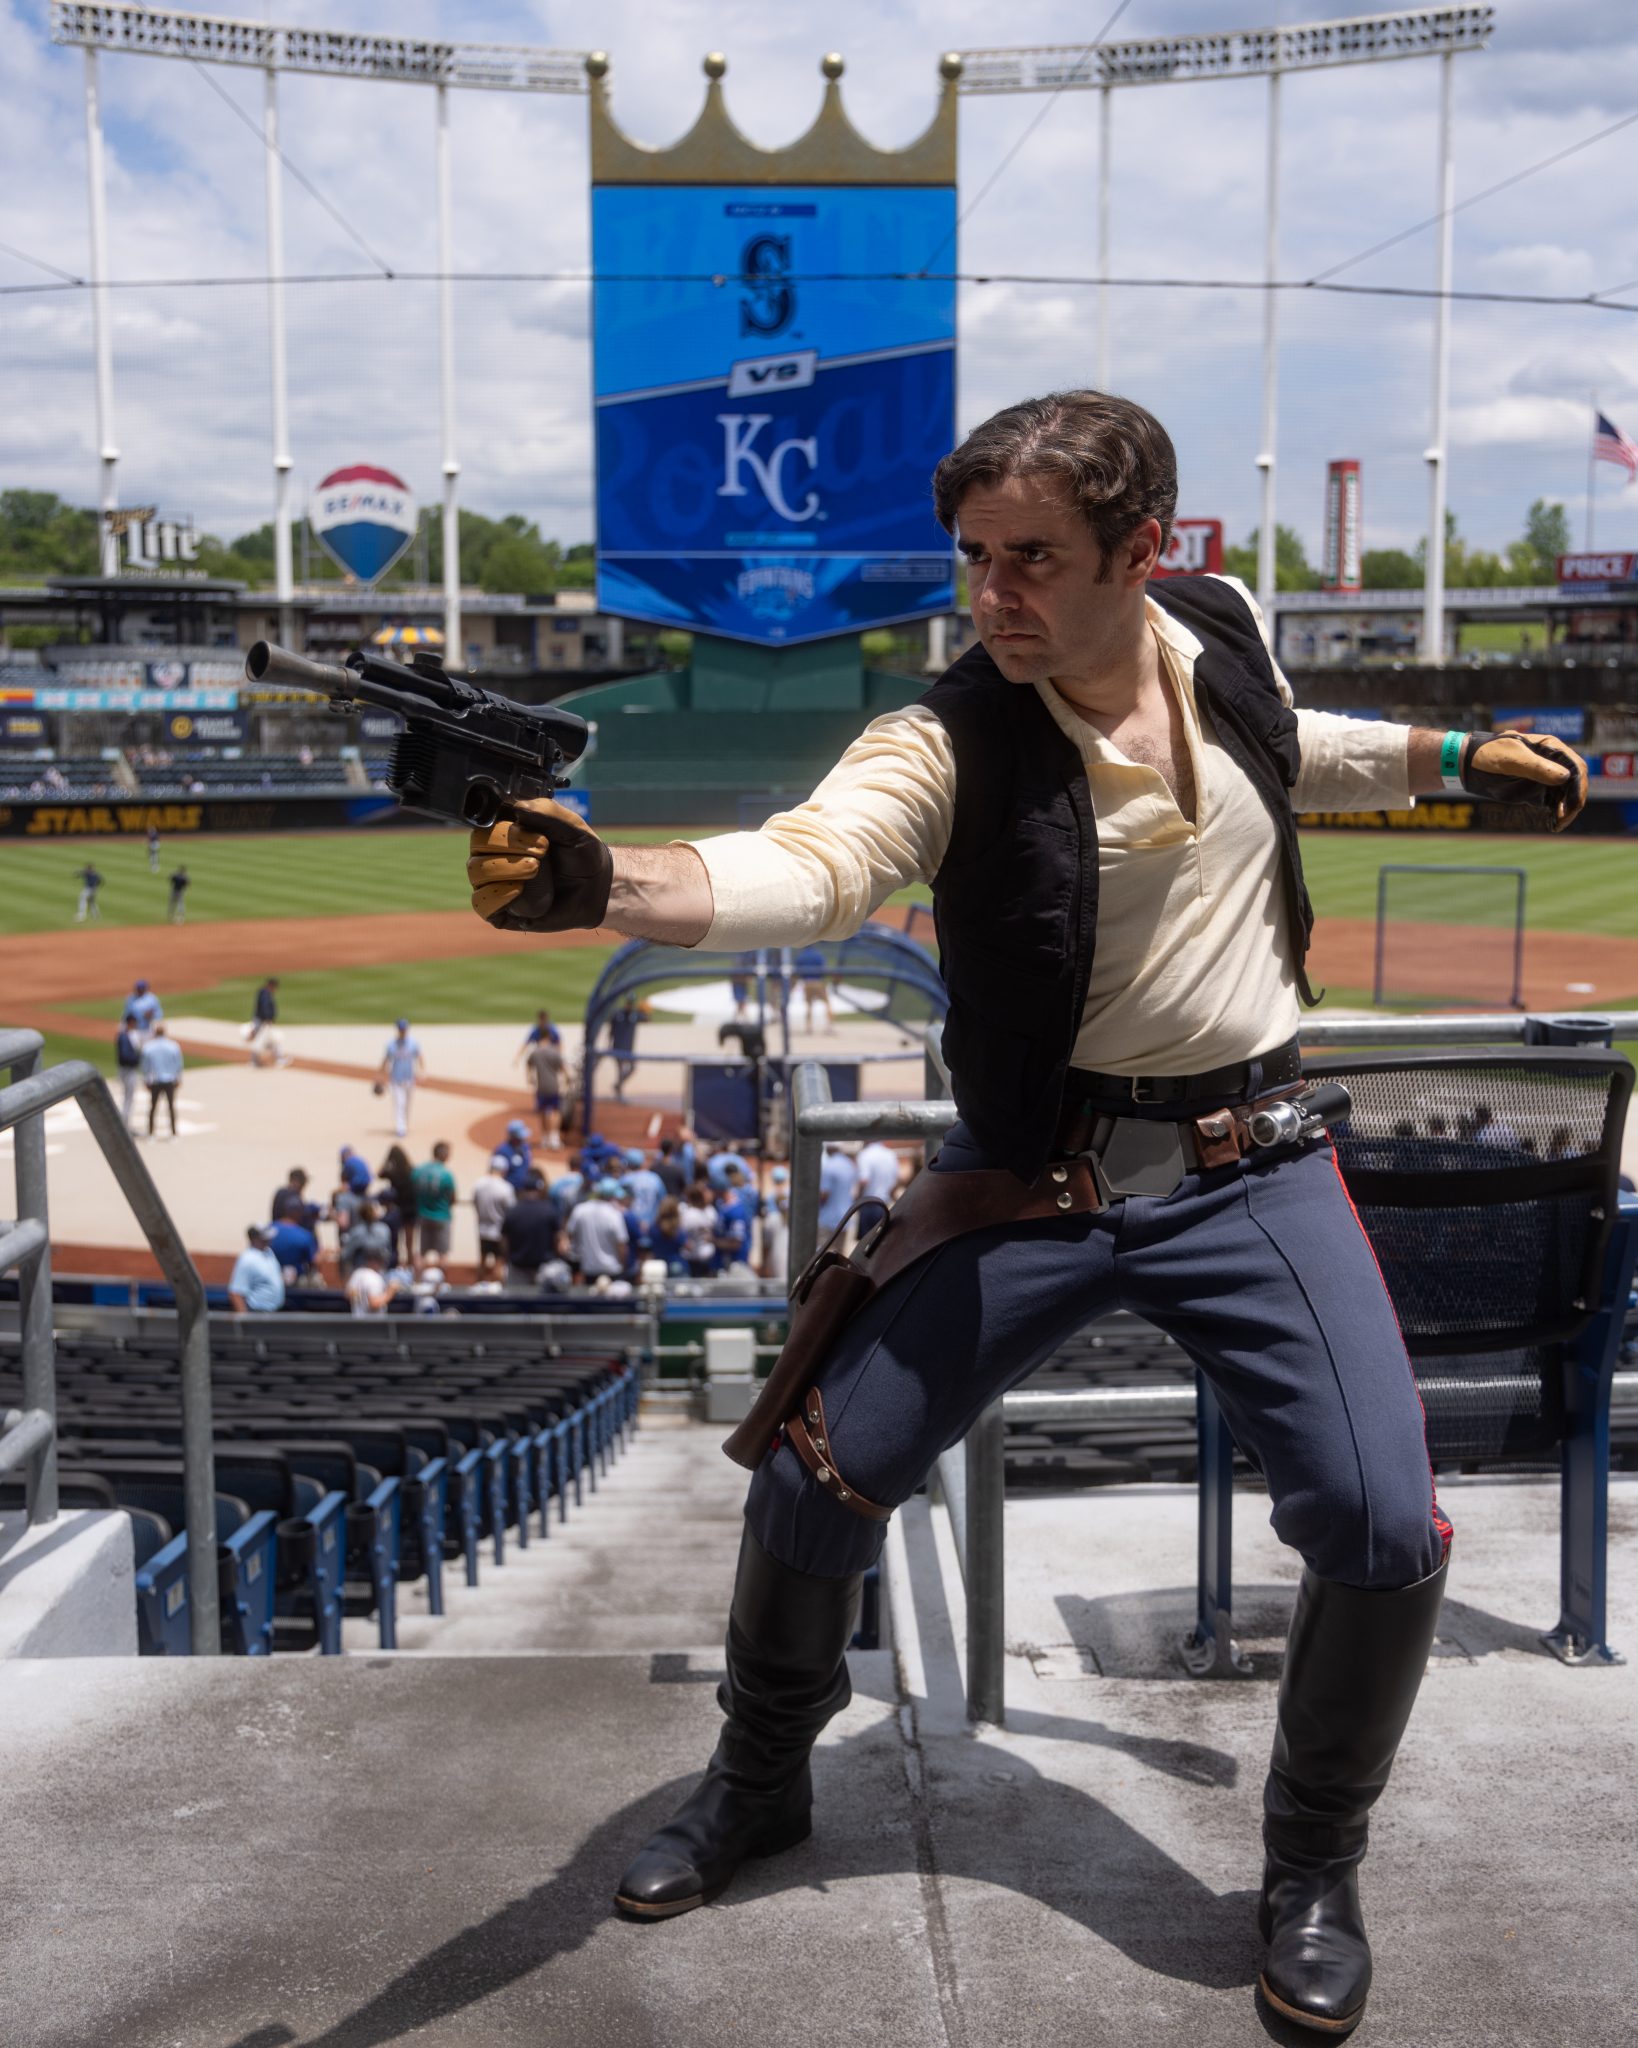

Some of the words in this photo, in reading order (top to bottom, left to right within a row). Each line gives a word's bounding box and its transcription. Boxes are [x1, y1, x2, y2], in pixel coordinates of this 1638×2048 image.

[748, 362, 799, 384] VS
[716, 413, 820, 522] KC
[1158, 527, 1213, 572] QT
[27, 807, 116, 833] STAR
[117, 804, 203, 832] WARS
[1386, 803, 1474, 829] WARS
